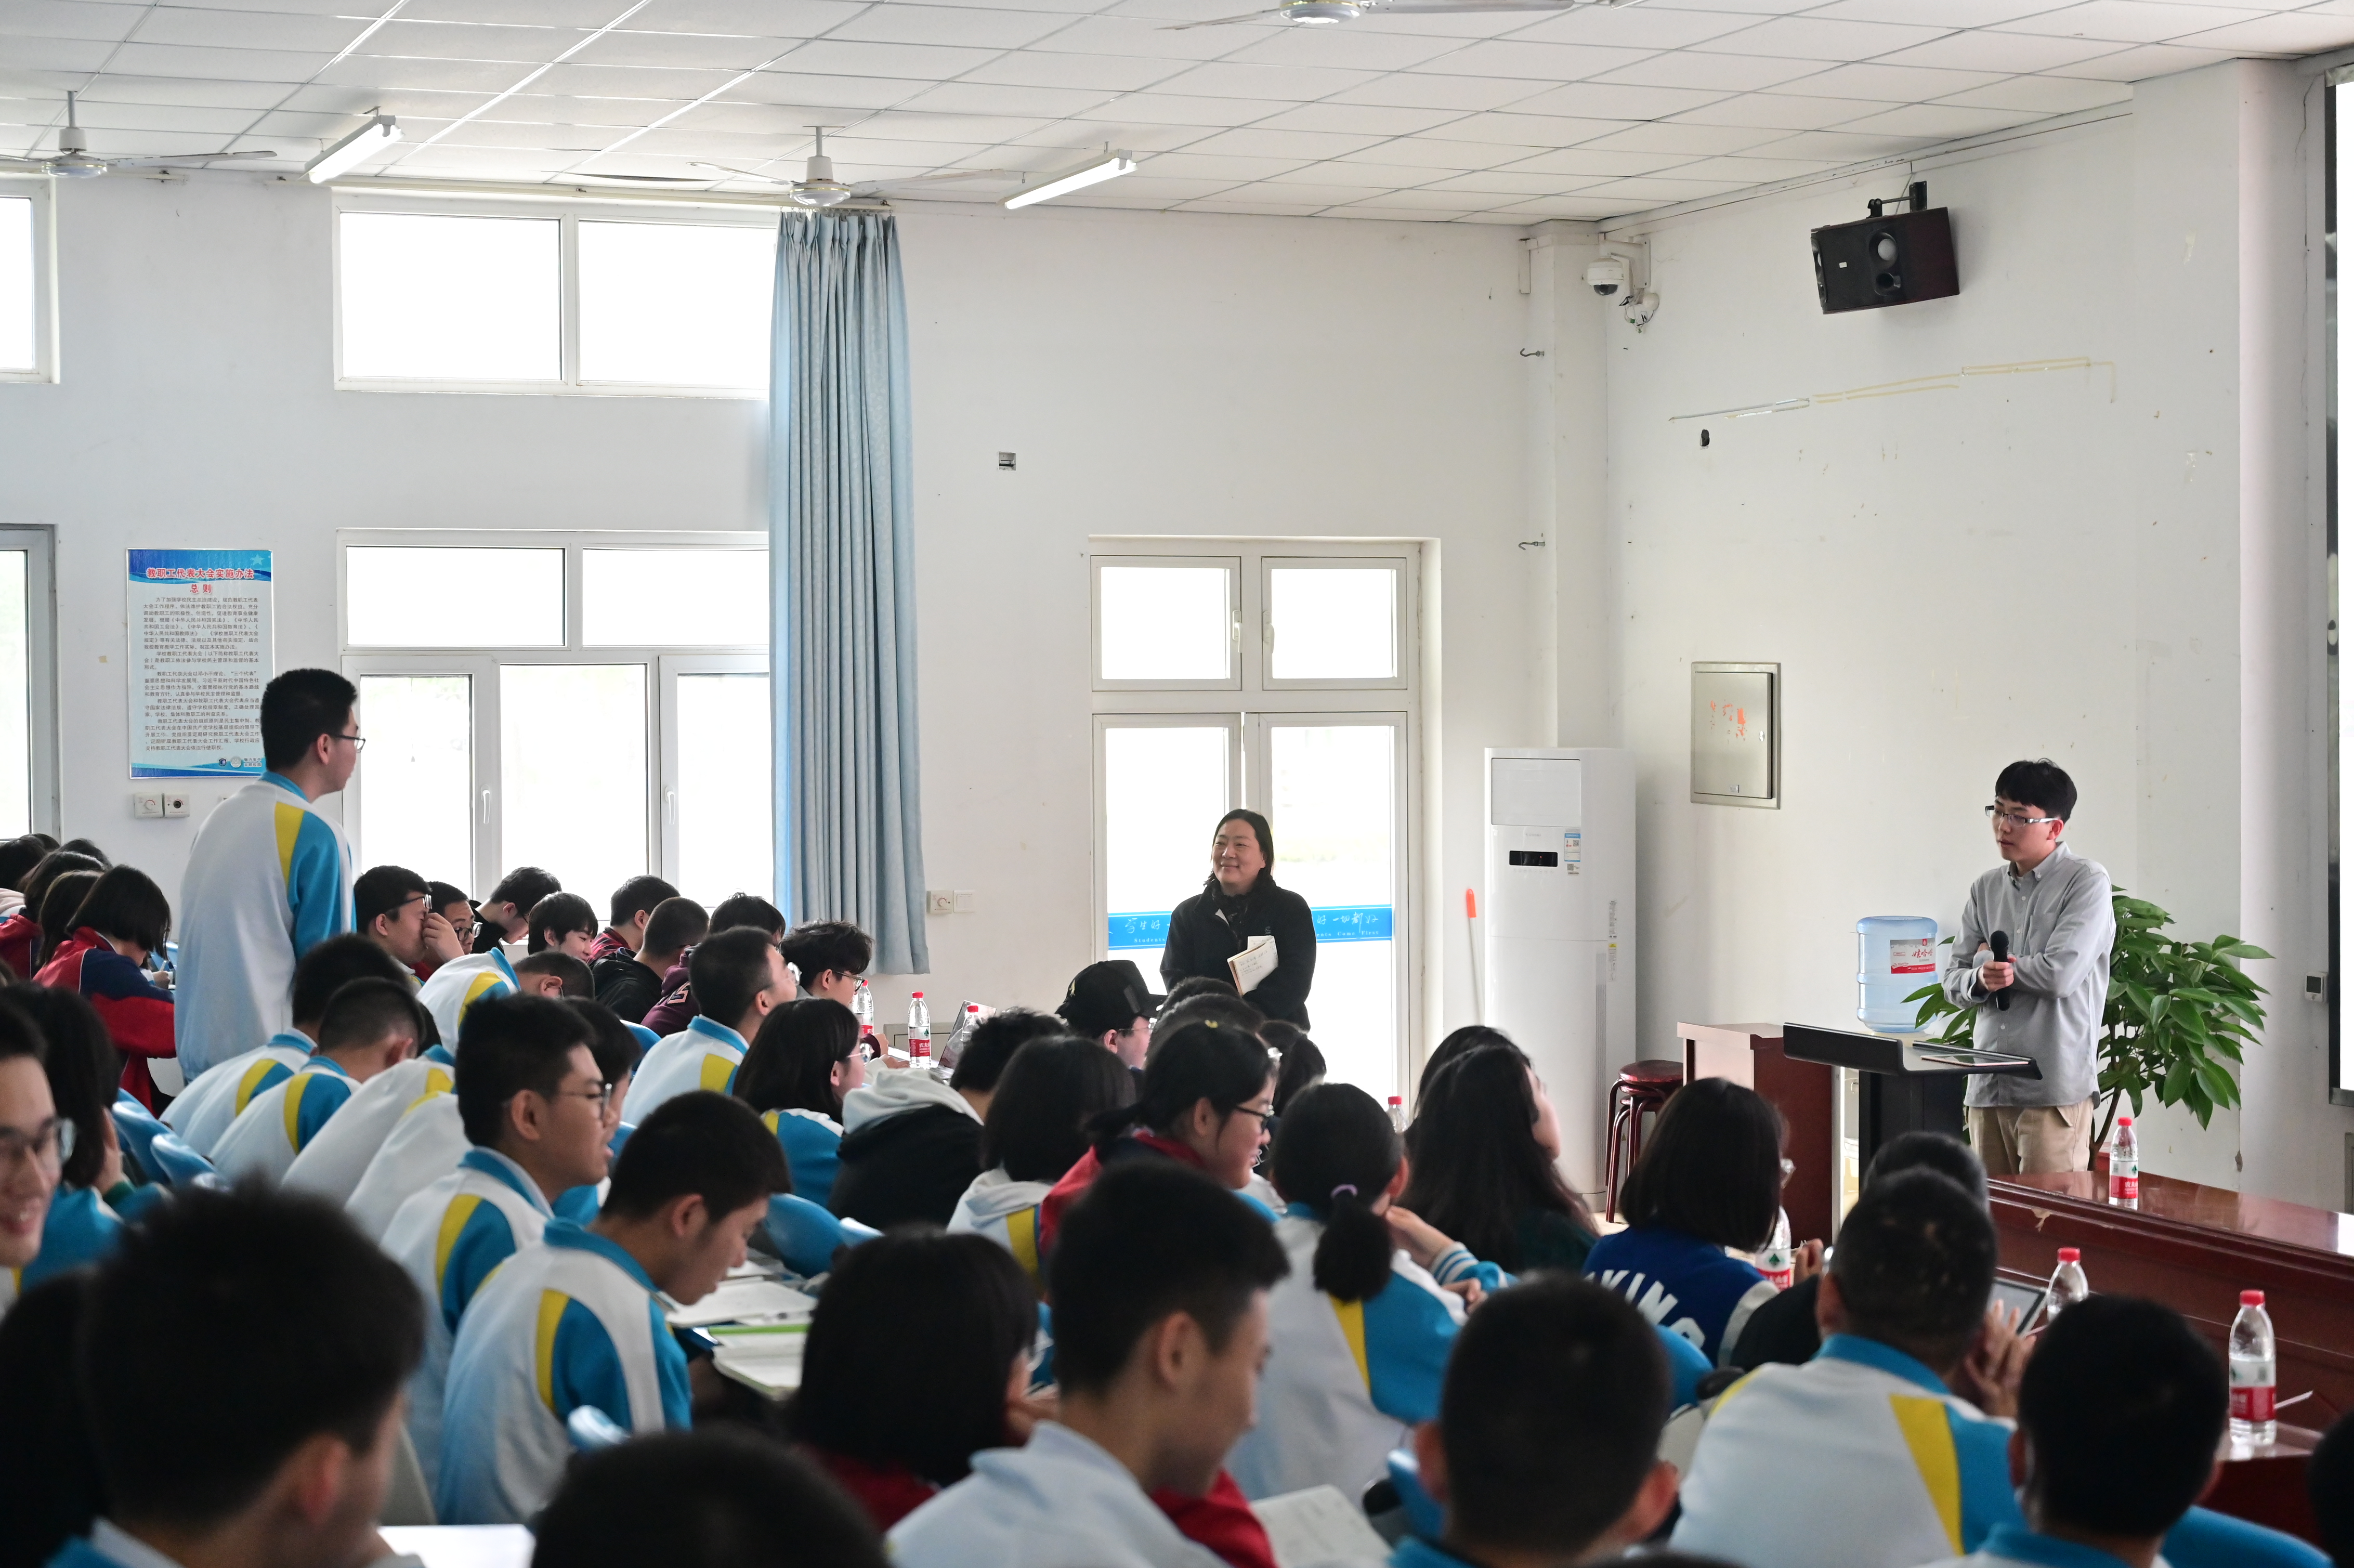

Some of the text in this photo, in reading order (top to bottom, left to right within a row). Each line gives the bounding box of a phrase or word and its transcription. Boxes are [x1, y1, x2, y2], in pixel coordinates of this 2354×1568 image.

[147, 568, 254, 578] 教职工代表大会实施办法
[1912, 948, 1933, 958] 娃哈哈
